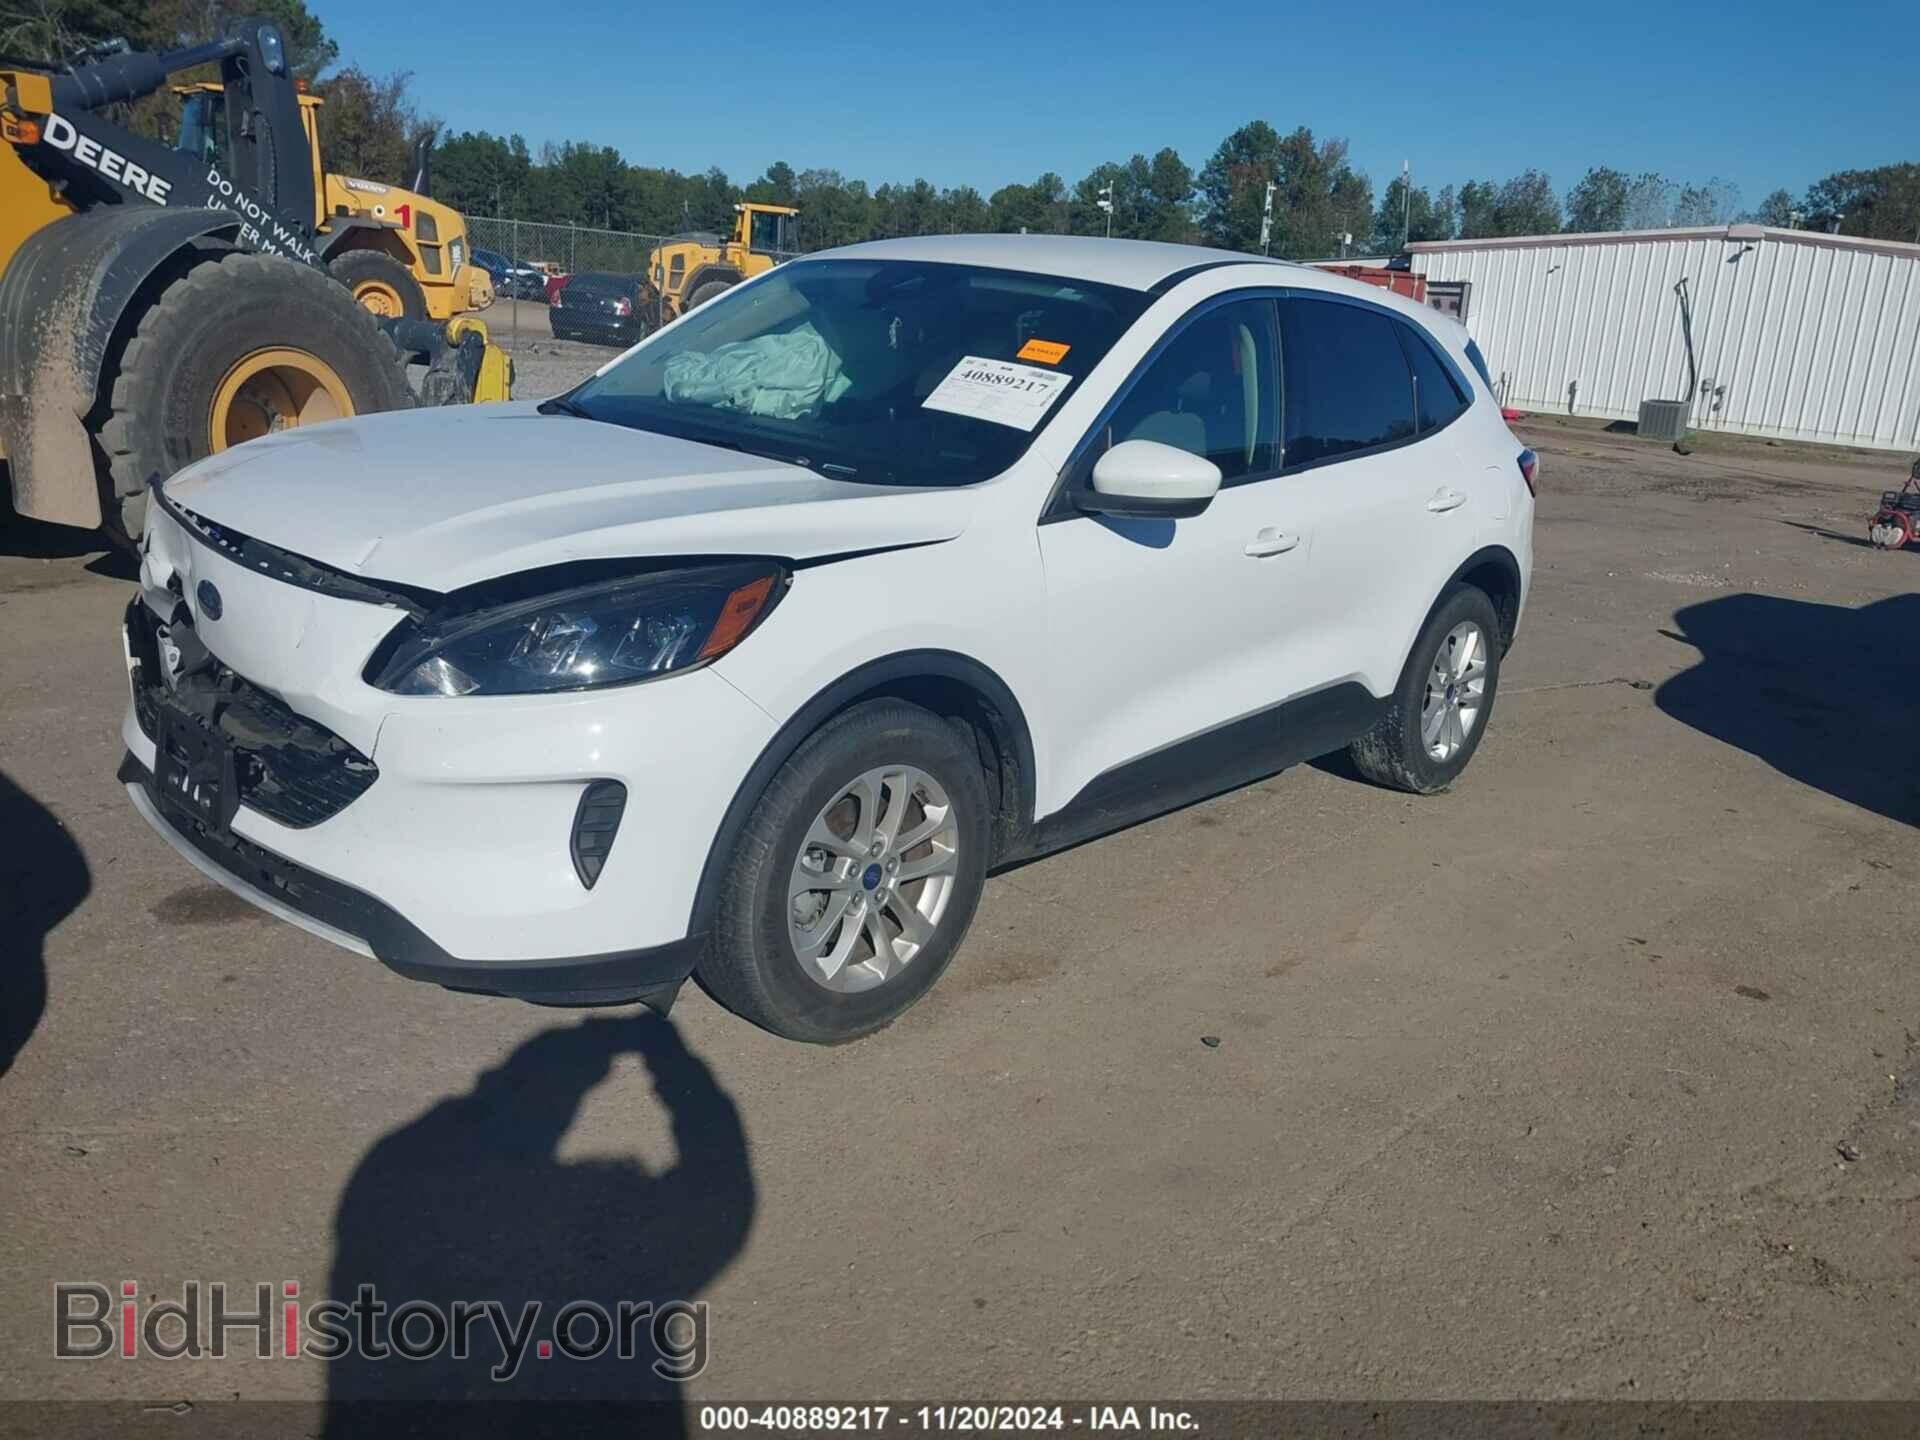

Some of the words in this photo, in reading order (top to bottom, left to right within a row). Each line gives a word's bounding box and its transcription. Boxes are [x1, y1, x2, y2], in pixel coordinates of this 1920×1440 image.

[43, 112, 172, 206] DEERE
[207, 169, 233, 196] DO
[234, 192, 272, 226] NOT
[273, 222, 315, 265] WALK
[394, 204, 411, 229] 1
[961, 368, 1048, 393] 40889217
